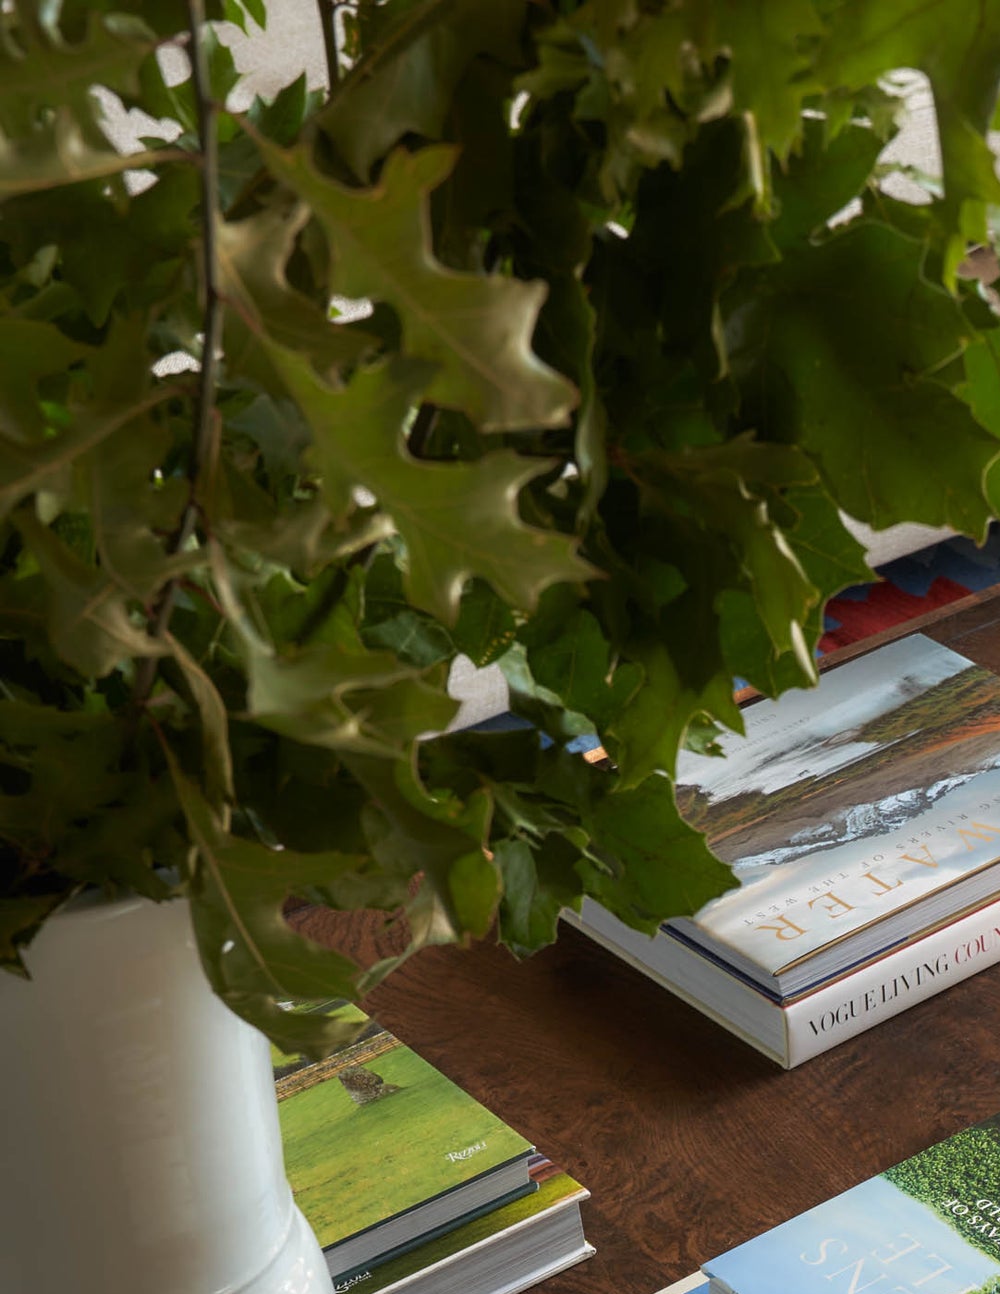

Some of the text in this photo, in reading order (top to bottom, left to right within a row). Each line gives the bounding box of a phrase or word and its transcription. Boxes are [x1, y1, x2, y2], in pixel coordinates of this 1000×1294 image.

[895, 811, 969, 851] RIVERS
[862, 853, 885, 872] OF
[807, 871, 850, 895] THE
[742, 896, 798, 928] WEST
[808, 990, 876, 1037] VOGUE
[881, 953, 950, 1004] LIVING
[941, 1198, 970, 1216] OF
